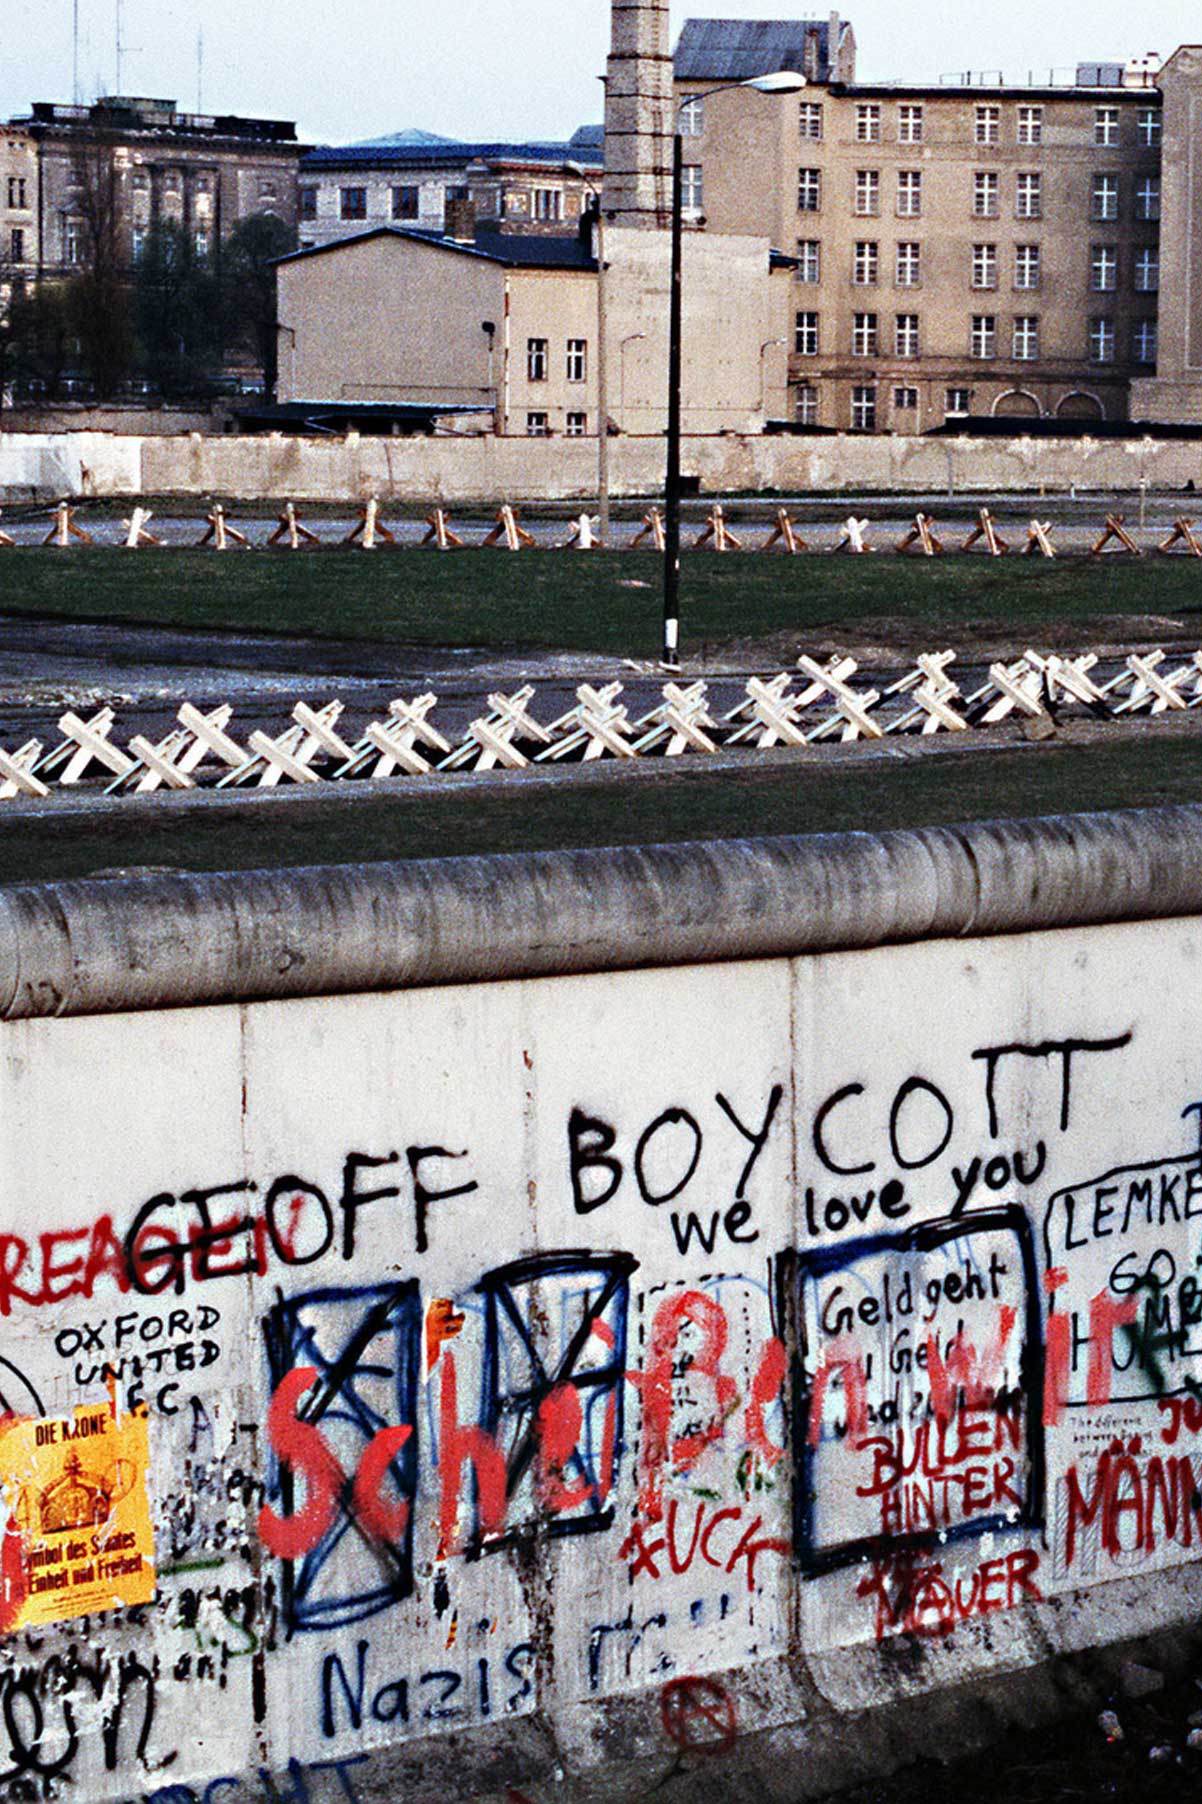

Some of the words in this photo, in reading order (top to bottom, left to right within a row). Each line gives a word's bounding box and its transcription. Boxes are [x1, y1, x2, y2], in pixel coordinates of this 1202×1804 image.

[124, 1146, 479, 1295] GEOFF
[566, 1028, 1133, 1214] BOYCOTT
[669, 1199, 760, 1255] we
[805, 1179, 912, 1236] love
[951, 1140, 1047, 1218] you
[822, 1270, 913, 1335] Geld
[925, 1253, 1008, 1322] geht
[54, 1305, 221, 1358] OXFORD
[75, 1339, 221, 1385] UNITED
[35, 1424, 57, 1447] DIE
